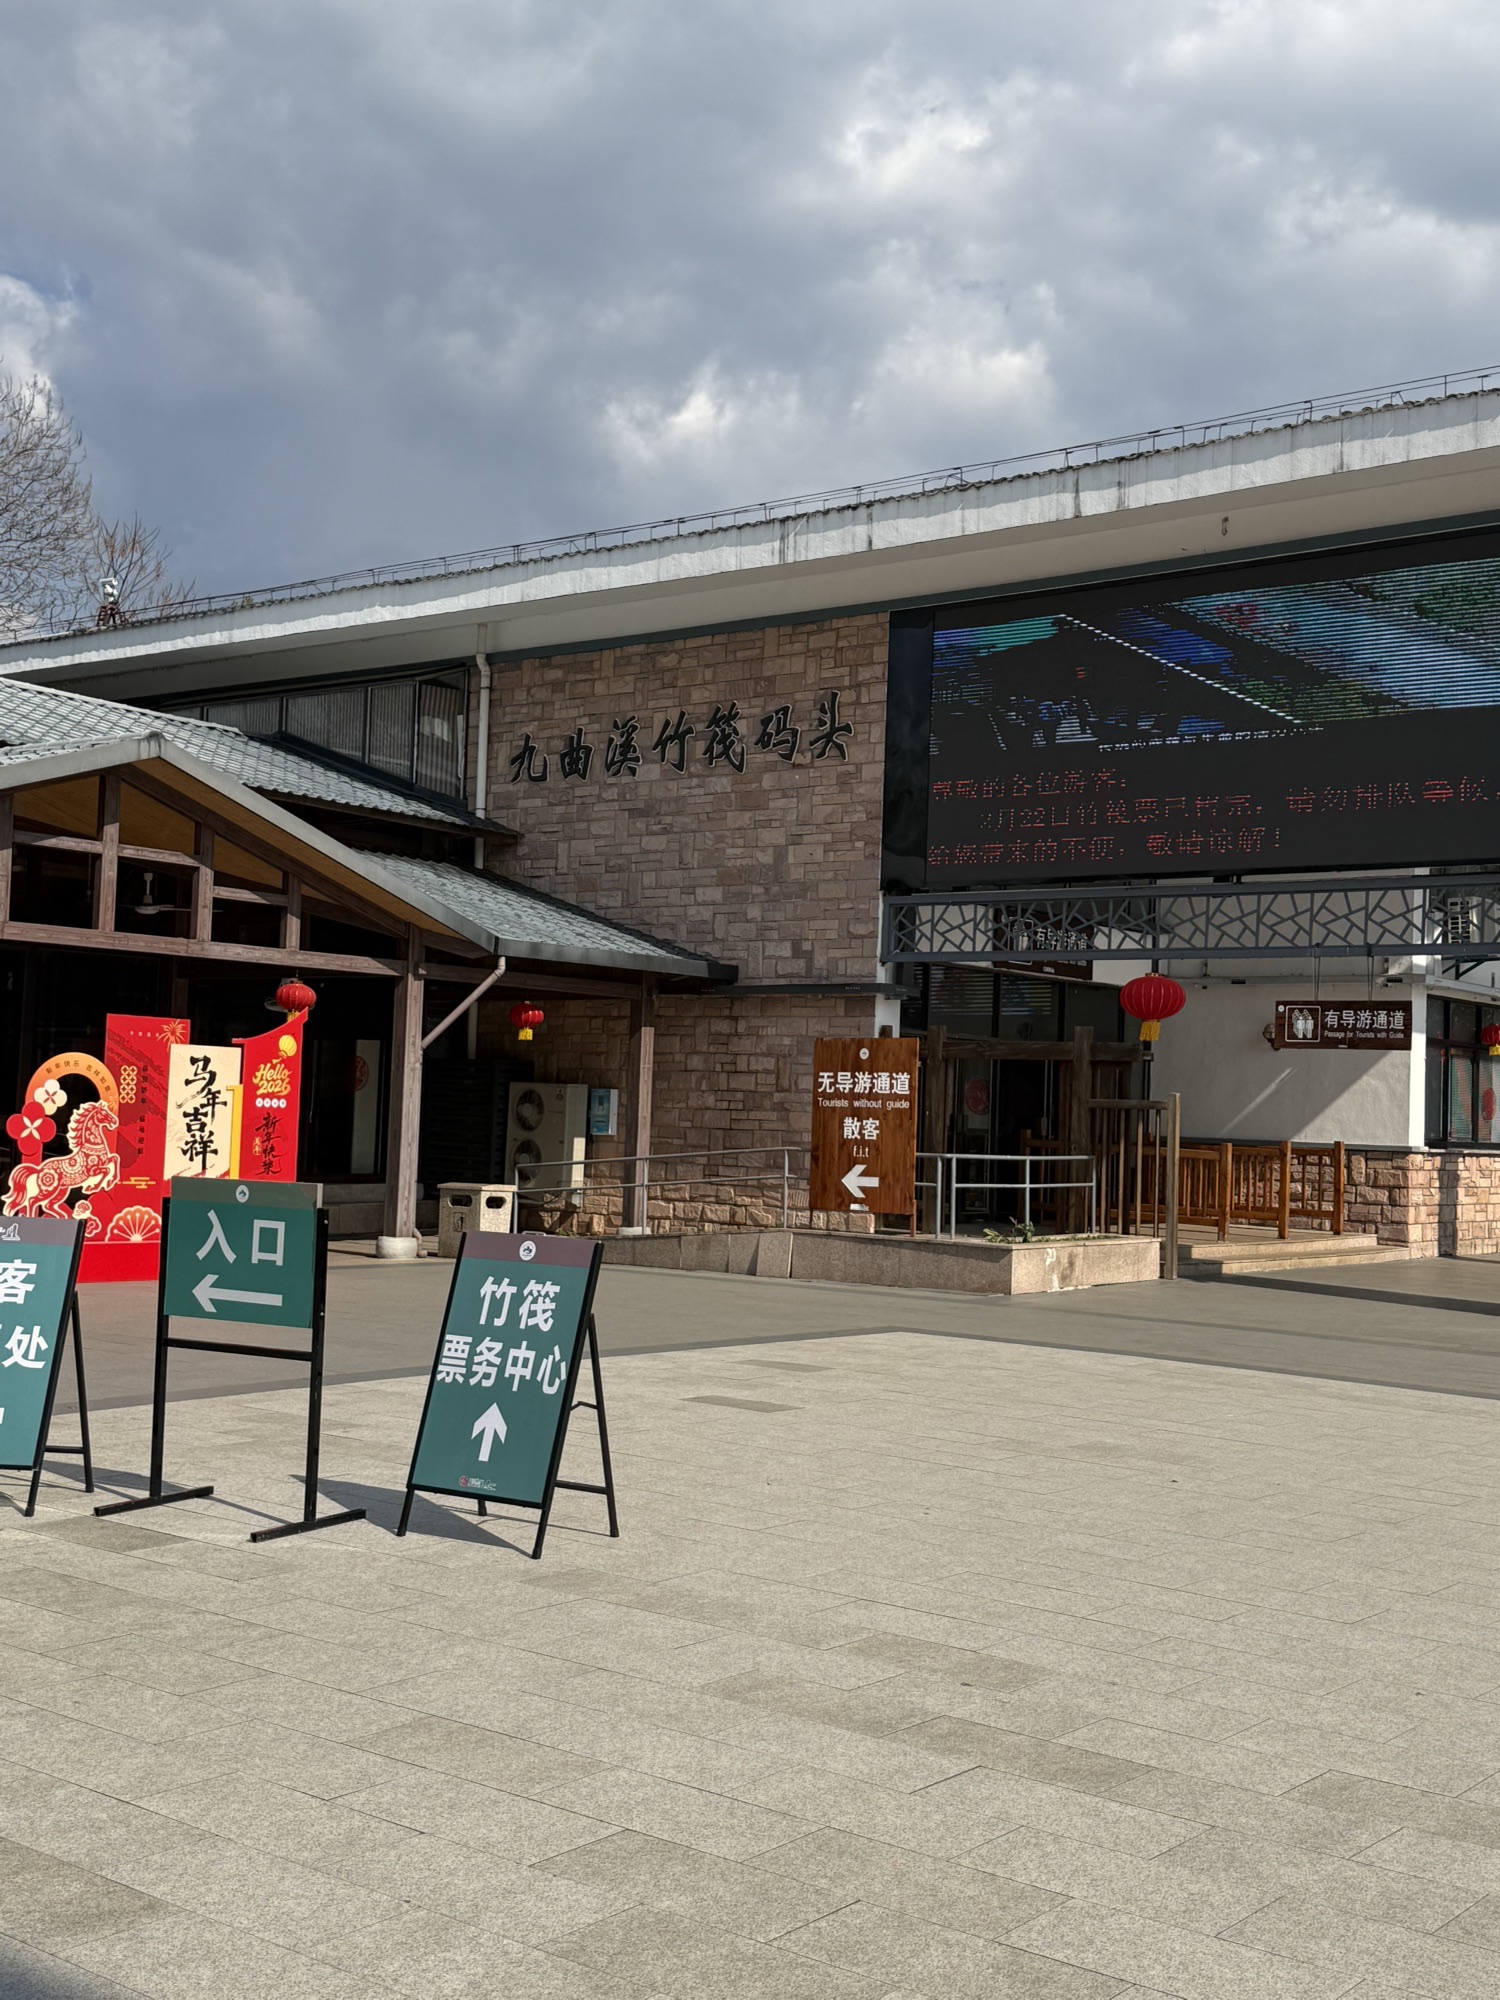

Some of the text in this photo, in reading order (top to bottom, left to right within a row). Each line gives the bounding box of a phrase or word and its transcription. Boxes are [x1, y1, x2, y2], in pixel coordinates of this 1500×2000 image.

[510, 690, 854, 784] 九曲溪竹筏码头
[1324, 1009, 1405, 1029] 有导游通道
[1324, 1030, 1345, 1038] Passage
[252, 1062, 293, 1084] Hello
[818, 1072, 910, 1095] 无导游通道
[256, 1079, 291, 1096] 2026
[183, 1055, 227, 1171] 马年吉祥
[818, 1097, 910, 1110] Tourists without guide
[843, 1117, 880, 1140] 散客
[853, 1145, 869, 1157] f.i.t
[196, 1209, 286, 1266] 入口
[0, 1259, 37, 1304] 客
[479, 1276, 561, 1332] 竹筏
[2, 1325, 49, 1368] 处
[436, 1334, 567, 1395] 票务中心
